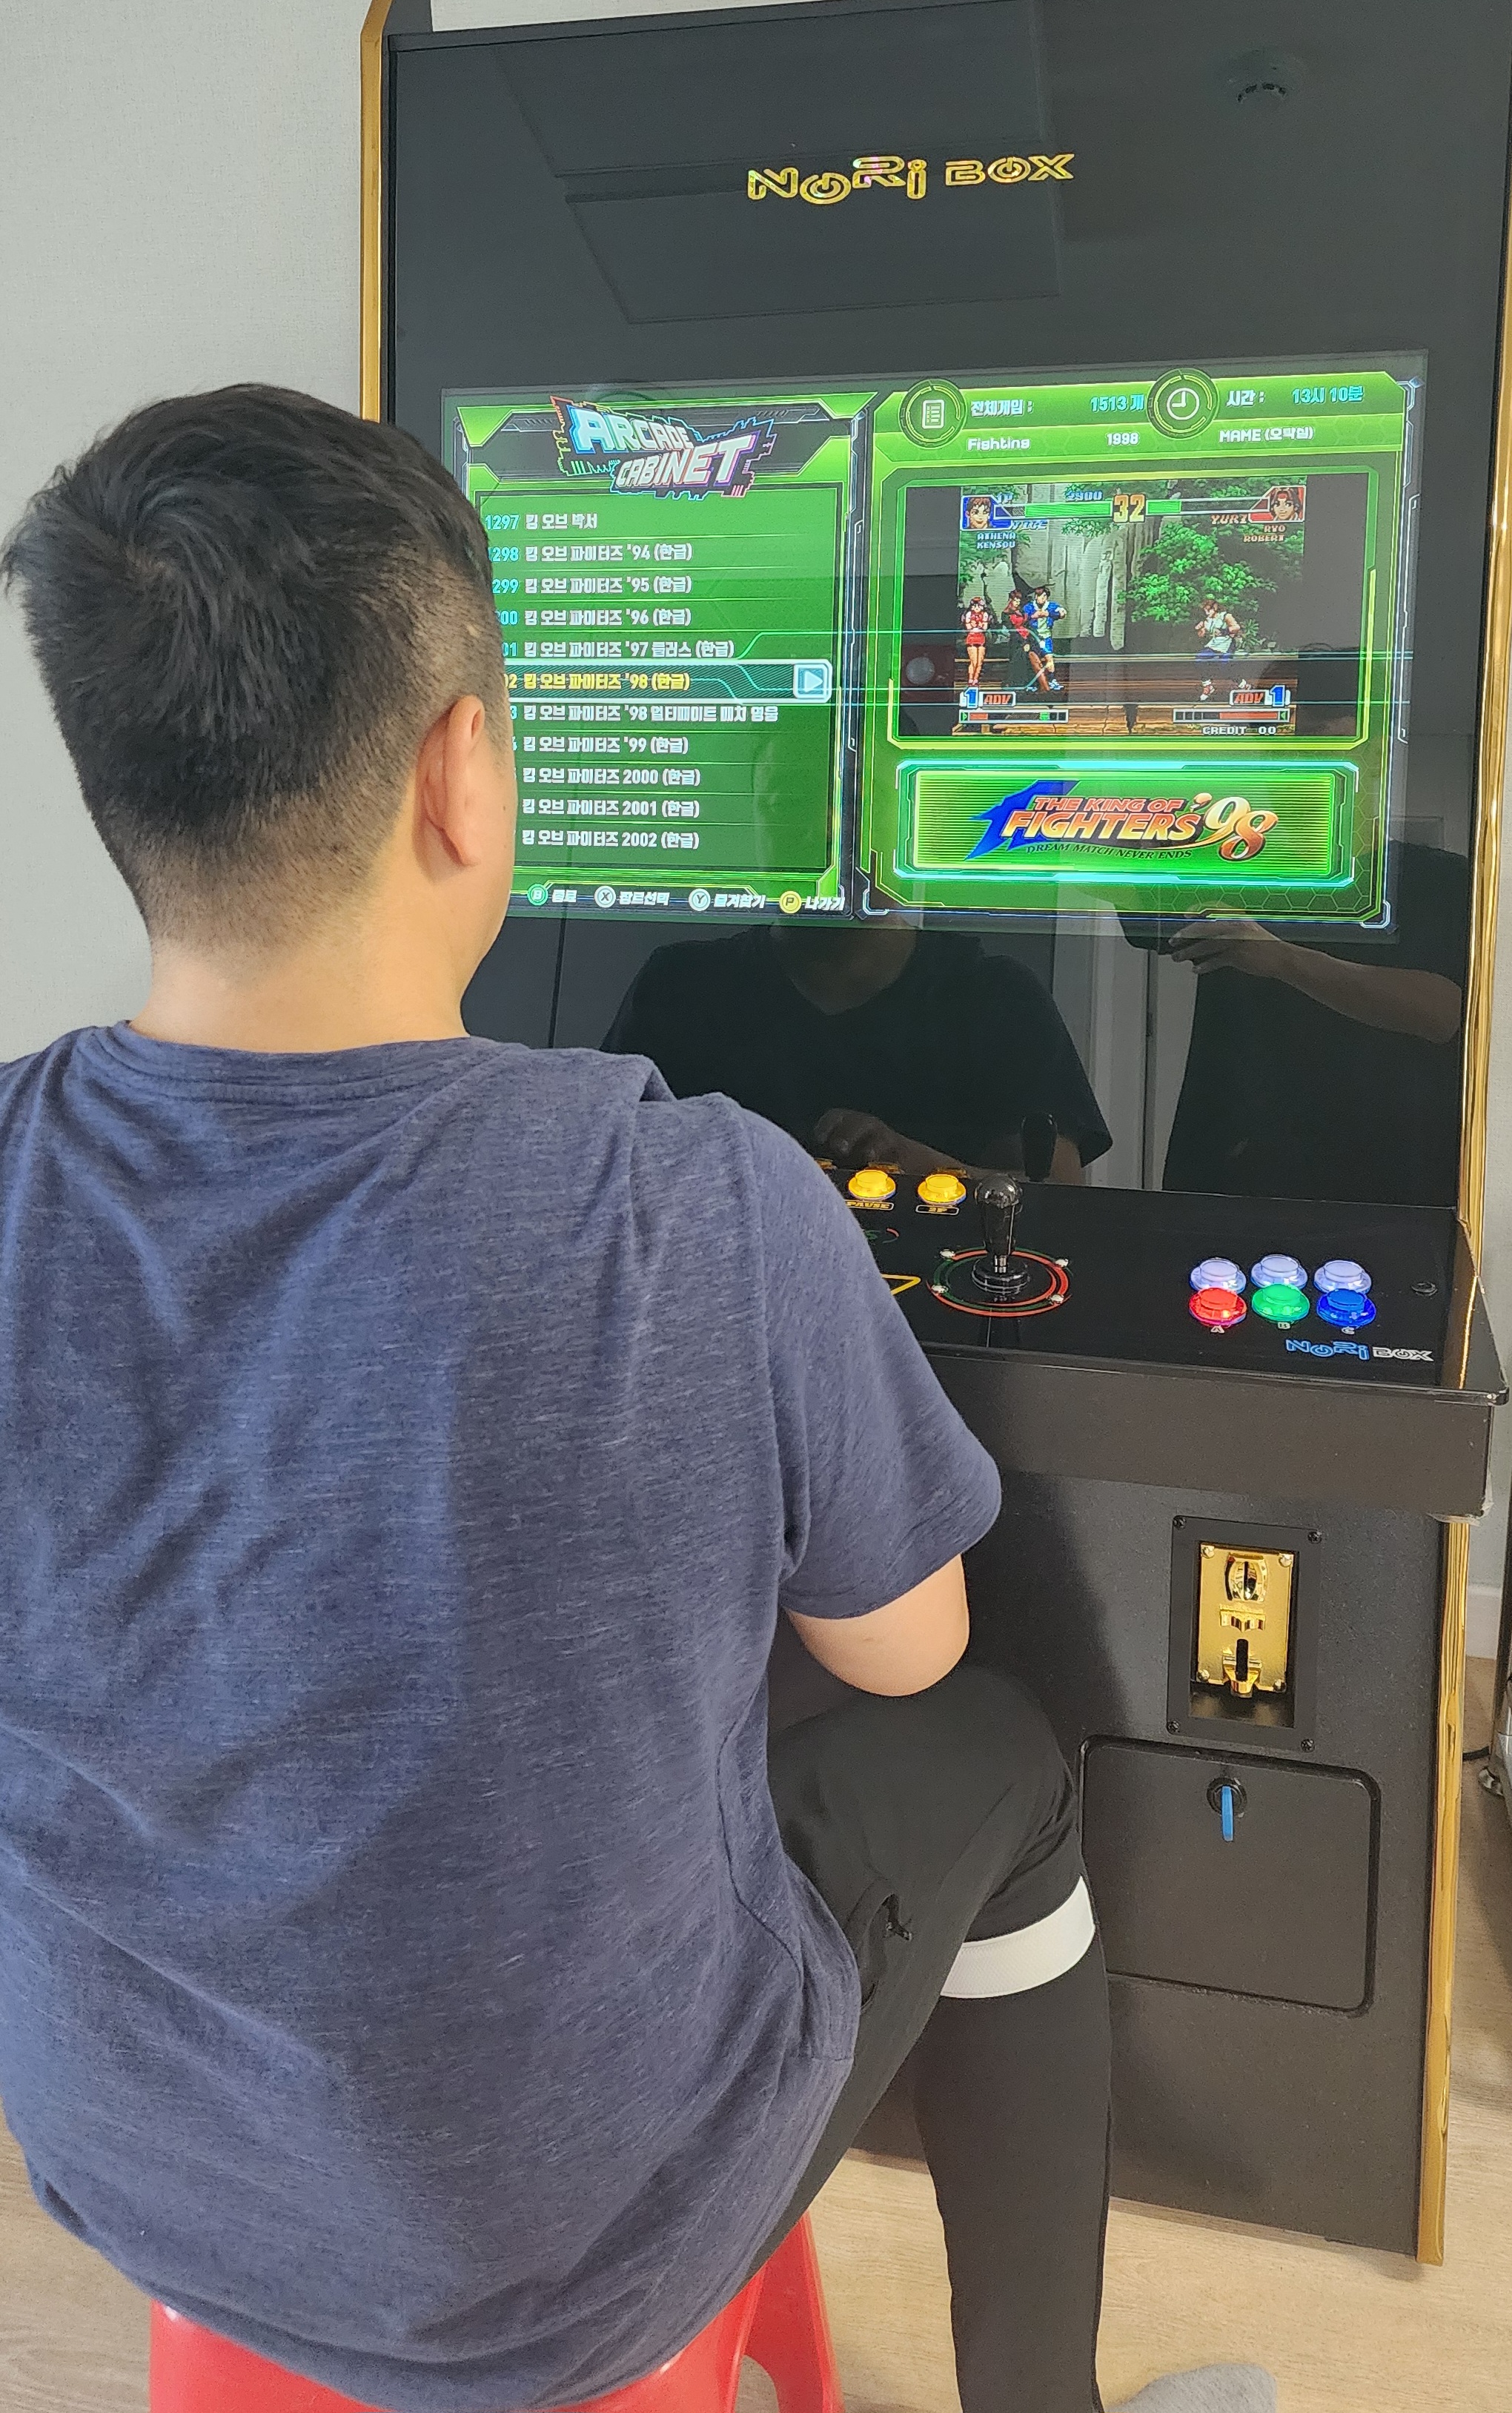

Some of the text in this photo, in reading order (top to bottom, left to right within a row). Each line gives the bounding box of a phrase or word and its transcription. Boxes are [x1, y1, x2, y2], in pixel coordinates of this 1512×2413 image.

[945, 153, 1075, 186] BOX
[1090, 396, 1127, 412] 1513
[1227, 390, 1255, 407] 시간
[1292, 387, 1325, 404] 13시
[1329, 385, 1364, 403] 10분
[567, 405, 694, 454] ARCADE
[967, 436, 1030, 451] Fighting
[1106, 432, 1139, 446] 1998
[1219, 429, 1261, 443] MAME
[614, 431, 760, 488] CABINET
[1113, 494, 1146, 523] 32
[485, 514, 520, 530] 1297
[542, 514, 568, 529] 오브
[1211, 514, 1248, 525] YURI
[978, 532, 1016, 540] ATHENA
[1264, 525, 1286, 533] RYO
[1244, 534, 1284, 543] ROBERT
[541, 546, 568, 561] 오브
[571, 545, 623, 561] 파이터즈
[626, 543, 650, 560] '94
[492, 578, 519, 594] 299
[541, 578, 567, 594] 오브
[570, 577, 623, 593] 파이터즈
[626, 576, 649, 592] '95
[497, 610, 518, 626] 00
[540, 610, 567, 625] 오브
[569, 610, 623, 625] 파이터즈
[626, 609, 649, 625] '96
[503, 643, 517, 657] 01
[540, 642, 566, 657] 오브
[569, 642, 622, 658] 파이터즈
[625, 641, 649, 657] '97
[540, 673, 566, 689] 오브
[568, 674, 621, 689] 파이터즈
[625, 672, 648, 689] '98
[964, 686, 1012, 709] 1 ADV
[1234, 685, 1286, 707] ADV 1
[540, 706, 566, 721] 오브
[568, 706, 620, 721] 파이터즈
[624, 704, 647, 721] '98
[1202, 726, 1247, 735] CREDIT
[539, 736, 565, 752] 오브
[568, 737, 620, 752] 파이터즈
[623, 737, 646, 752] '99
[539, 768, 564, 783] 오브
[567, 768, 620, 784] 파이터즈
[623, 769, 658, 784] 2000
[538, 799, 564, 815] 오브
[567, 800, 619, 815] 파이터즈
[622, 801, 657, 815] 2001
[1035, 798, 1186, 812] THE KING OF
[1001, 811, 1202, 840] FIGHTERS
[537, 830, 563, 845] 오브
[566, 831, 618, 847] 파이터즈
[621, 833, 657, 847] 2002
[1027, 843, 1192, 859] DREAM MATCH NEVER ENDS
[1210, 1325, 1224, 1334] A
[1342, 1326, 1355, 1334] C
[1373, 1346, 1433, 1362] BOX
